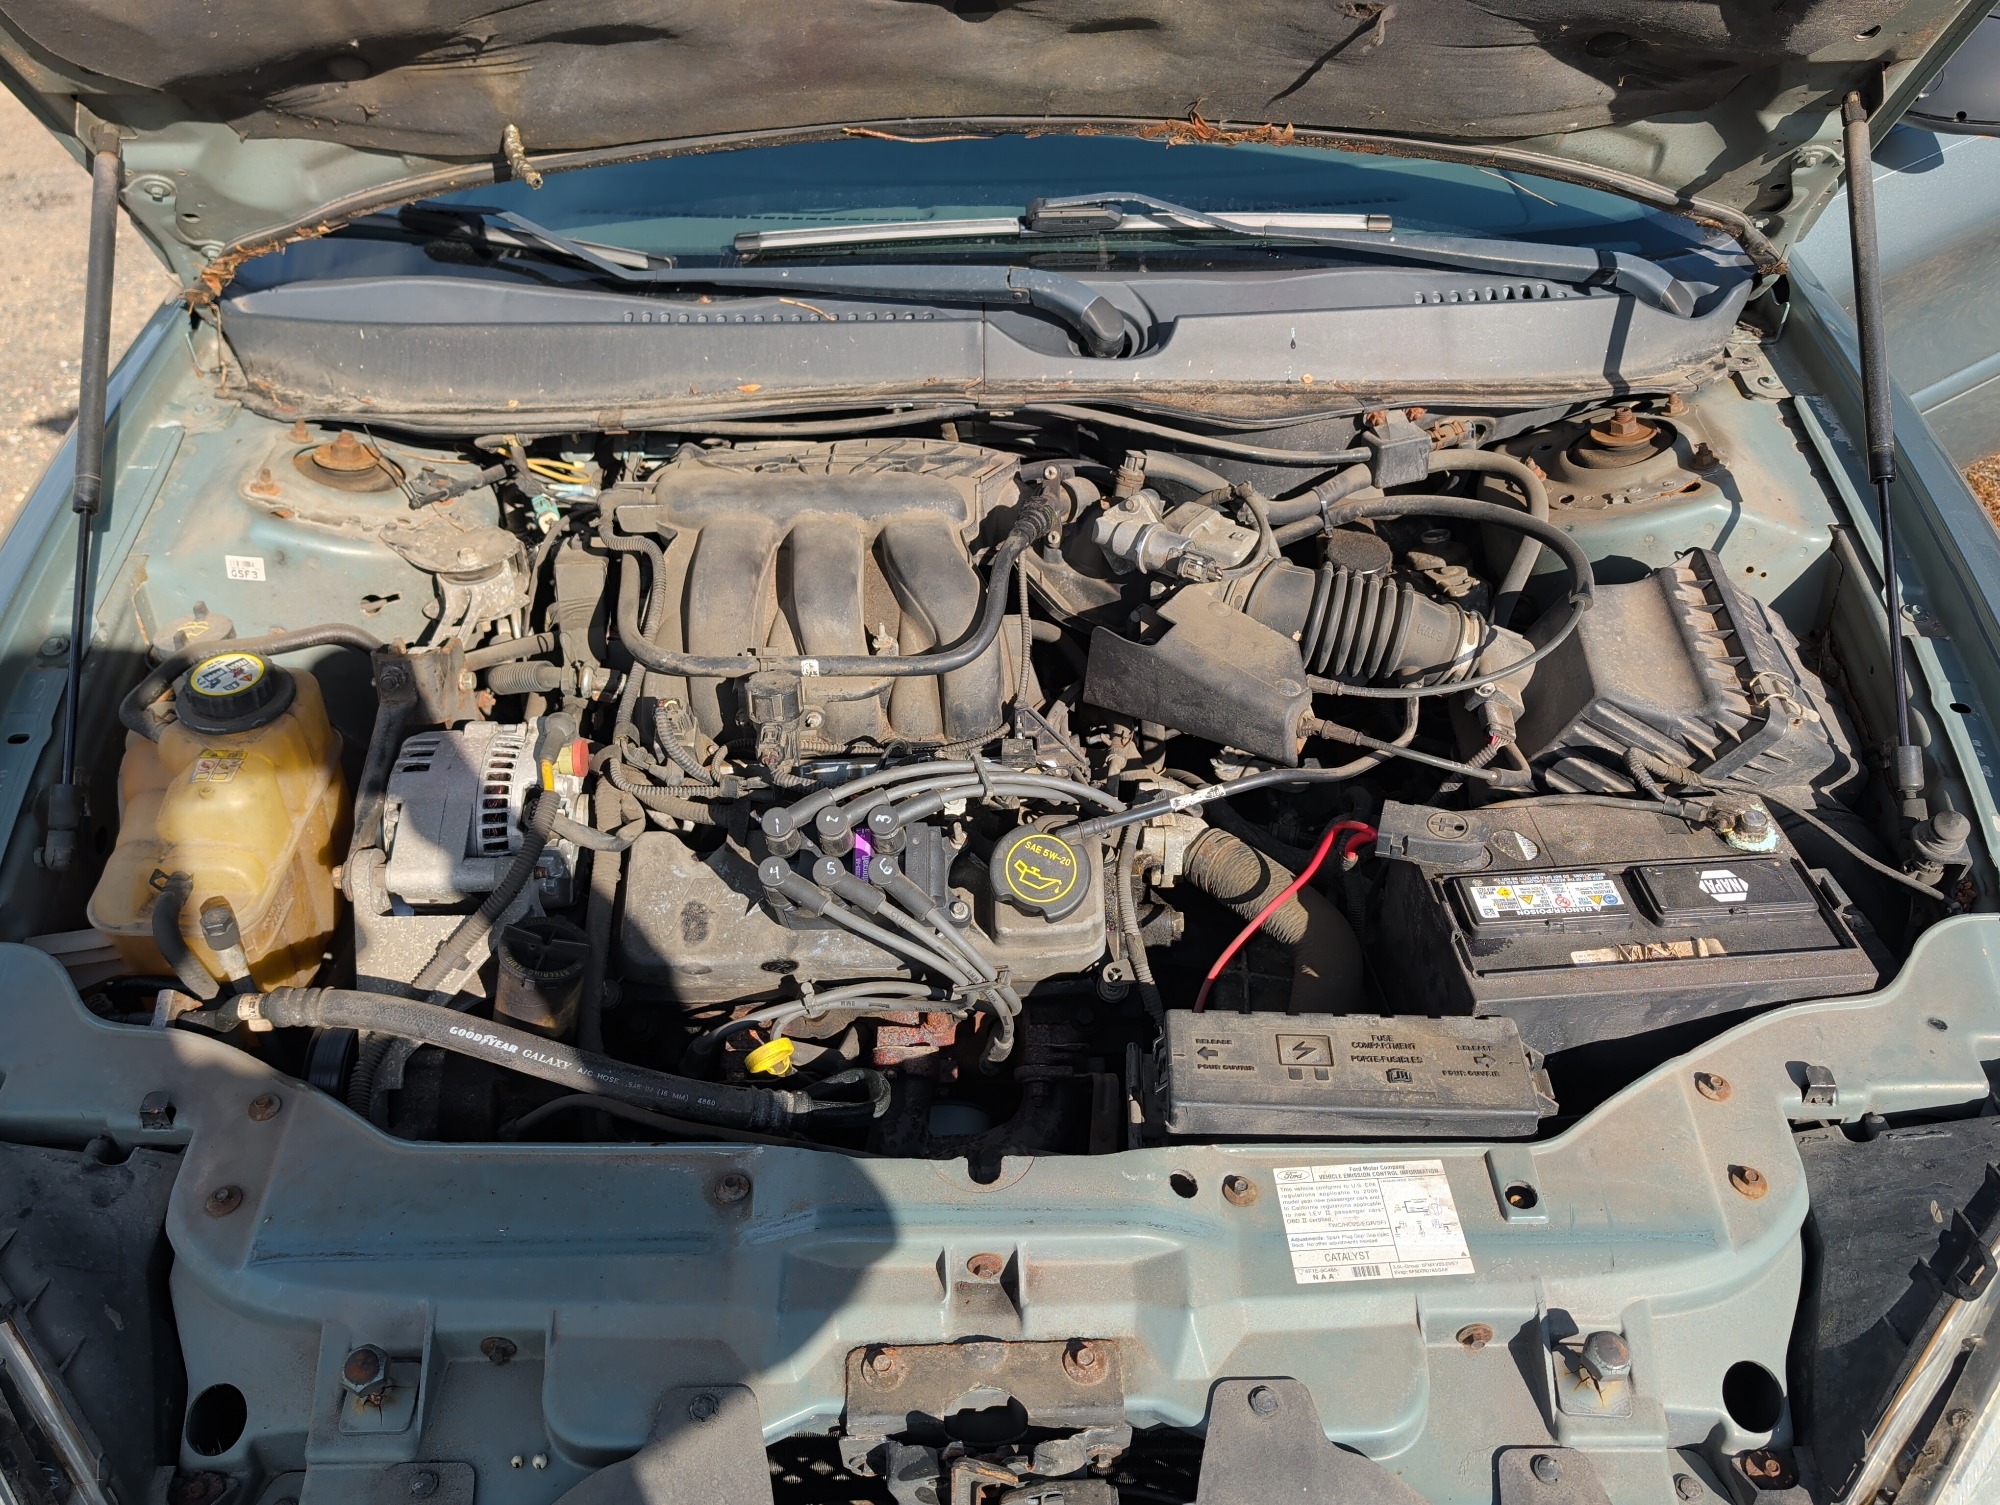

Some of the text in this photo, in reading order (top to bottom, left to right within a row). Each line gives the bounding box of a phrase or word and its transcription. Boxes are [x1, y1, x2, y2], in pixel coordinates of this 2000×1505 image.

[775, 817, 780, 833] 1
[875, 814, 892, 824] 3
[1025, 841, 1071, 867] SAE 5W-20
[769, 866, 780, 879] 4
[826, 861, 836, 875] 5
[879, 858, 893, 875] 6
[1702, 878, 1744, 894] NAPA
[1516, 906, 1592, 916] DANGER/POISON
[528, 969, 570, 978] STEERING
[1371, 1034, 1394, 1042] FUSE
[1351, 1041, 1416, 1050] COMPARTMENT
[449, 1026, 519, 1054] GOODYEAR
[522, 1049, 573, 1070] GALAXY
[577, 1067, 593, 1077] A/C
[597, 1072, 619, 1085] HOSE
[1281, 1192, 1316, 1200] regulations
[1319, 1190, 1350, 1198] applicable
[1326, 1196, 1355, 1204] passenger
[1324, 1250, 1370, 1262] CATALYST
